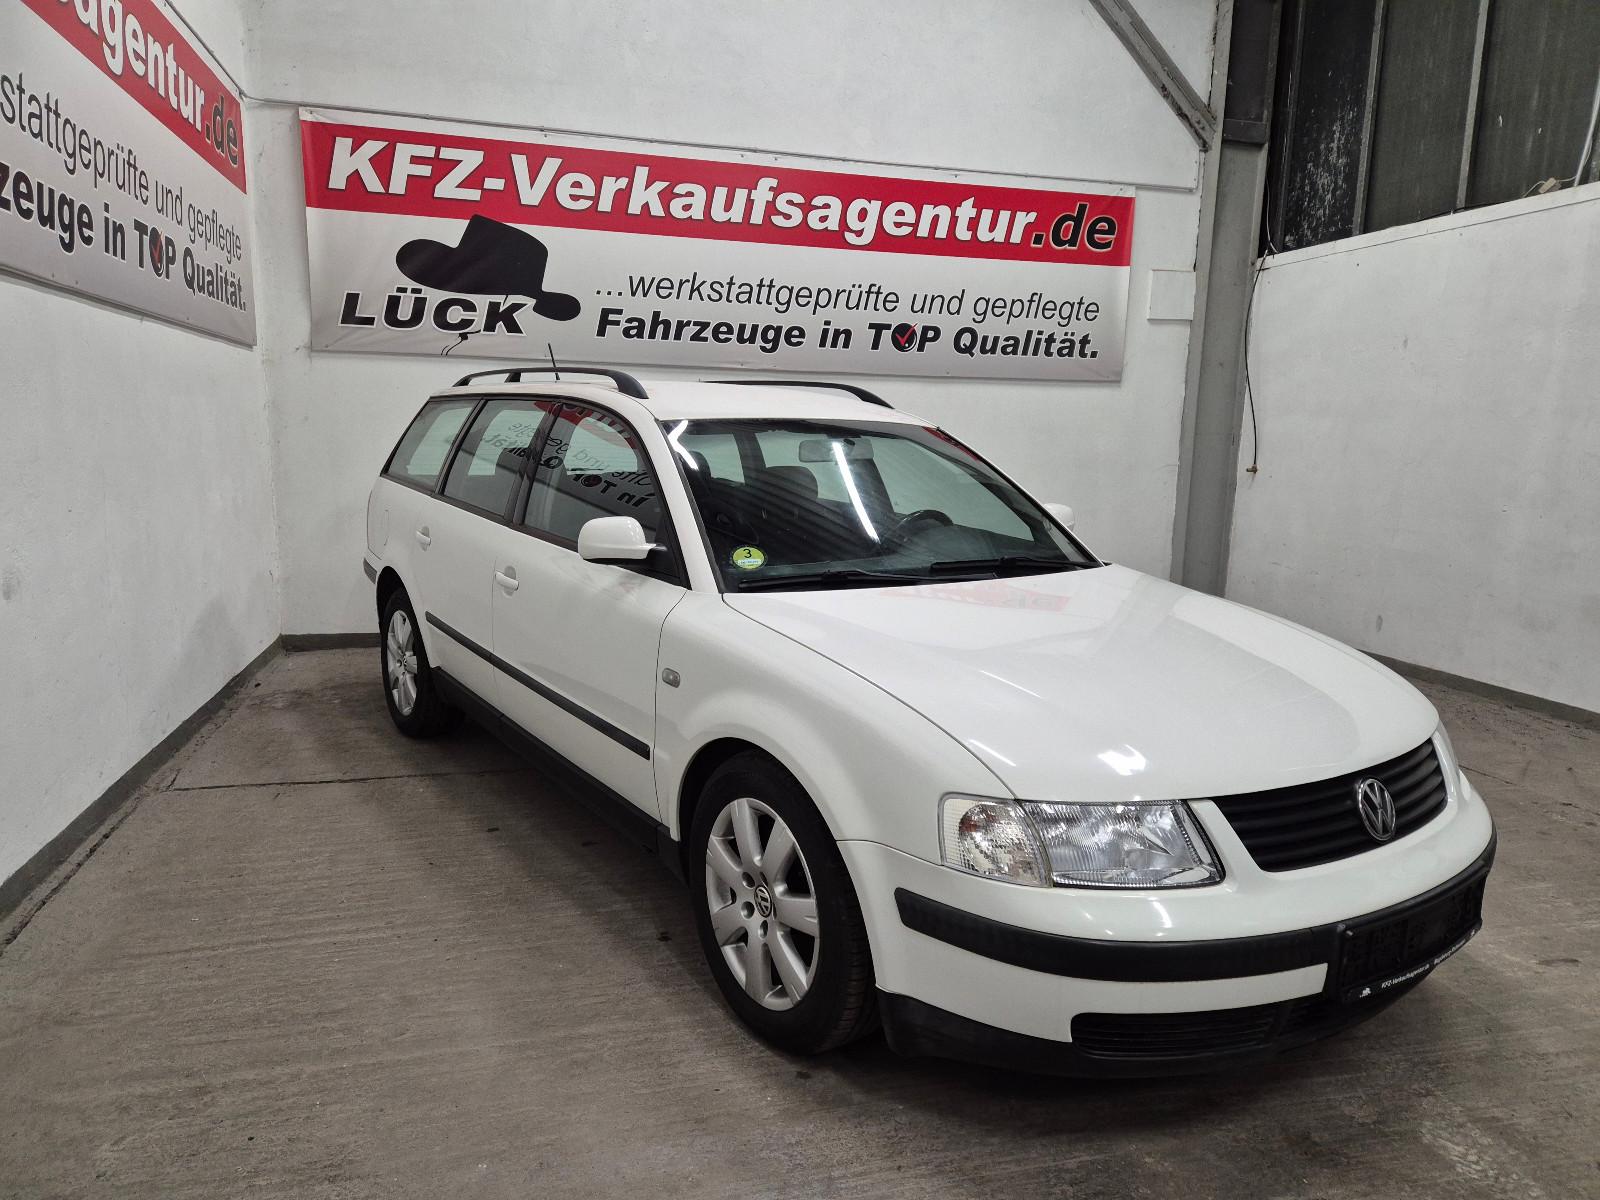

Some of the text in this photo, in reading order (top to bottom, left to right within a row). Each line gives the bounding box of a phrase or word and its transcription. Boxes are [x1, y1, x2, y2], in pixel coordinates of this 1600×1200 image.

[60, 0, 239, 167] agentur.de
[0, 72, 242, 265] stattgeprüfte und gepflegte
[328, 136, 1118, 250] KFZ-Verkaufsagentur.de
[104, 202, 126, 261] in
[182, 246, 246, 312] Qualität.
[340, 286, 529, 334] LÜCK
[595, 307, 1100, 359] Fahrzeuge in TOP Qualität.
[910, 289, 966, 316] und
[972, 292, 1100, 328] gepflegte
[743, 548, 752, 559] 3
